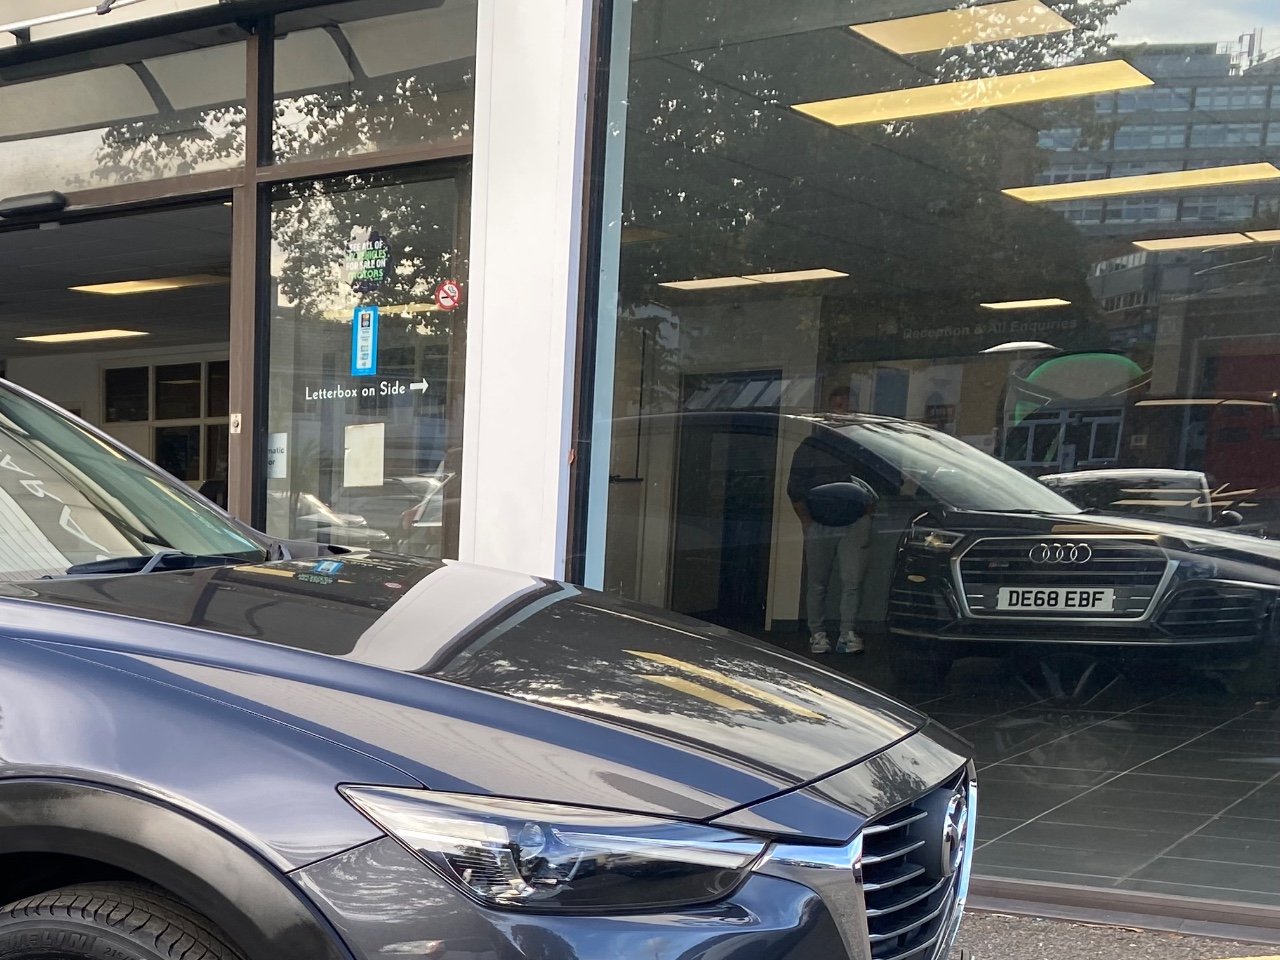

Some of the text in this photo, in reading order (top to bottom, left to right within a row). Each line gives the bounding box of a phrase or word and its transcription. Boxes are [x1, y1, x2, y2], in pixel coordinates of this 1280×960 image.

[362, 241, 374, 250] ALL
[374, 239, 384, 249] OF
[346, 259, 386, 271] FOR SALE ON
[989, 321, 1006, 334] All
[1009, 319, 1078, 333] Enquiries
[305, 380, 406, 400] Letterbox on Side
[1008, 590, 1105, 607] DE68 EBF
